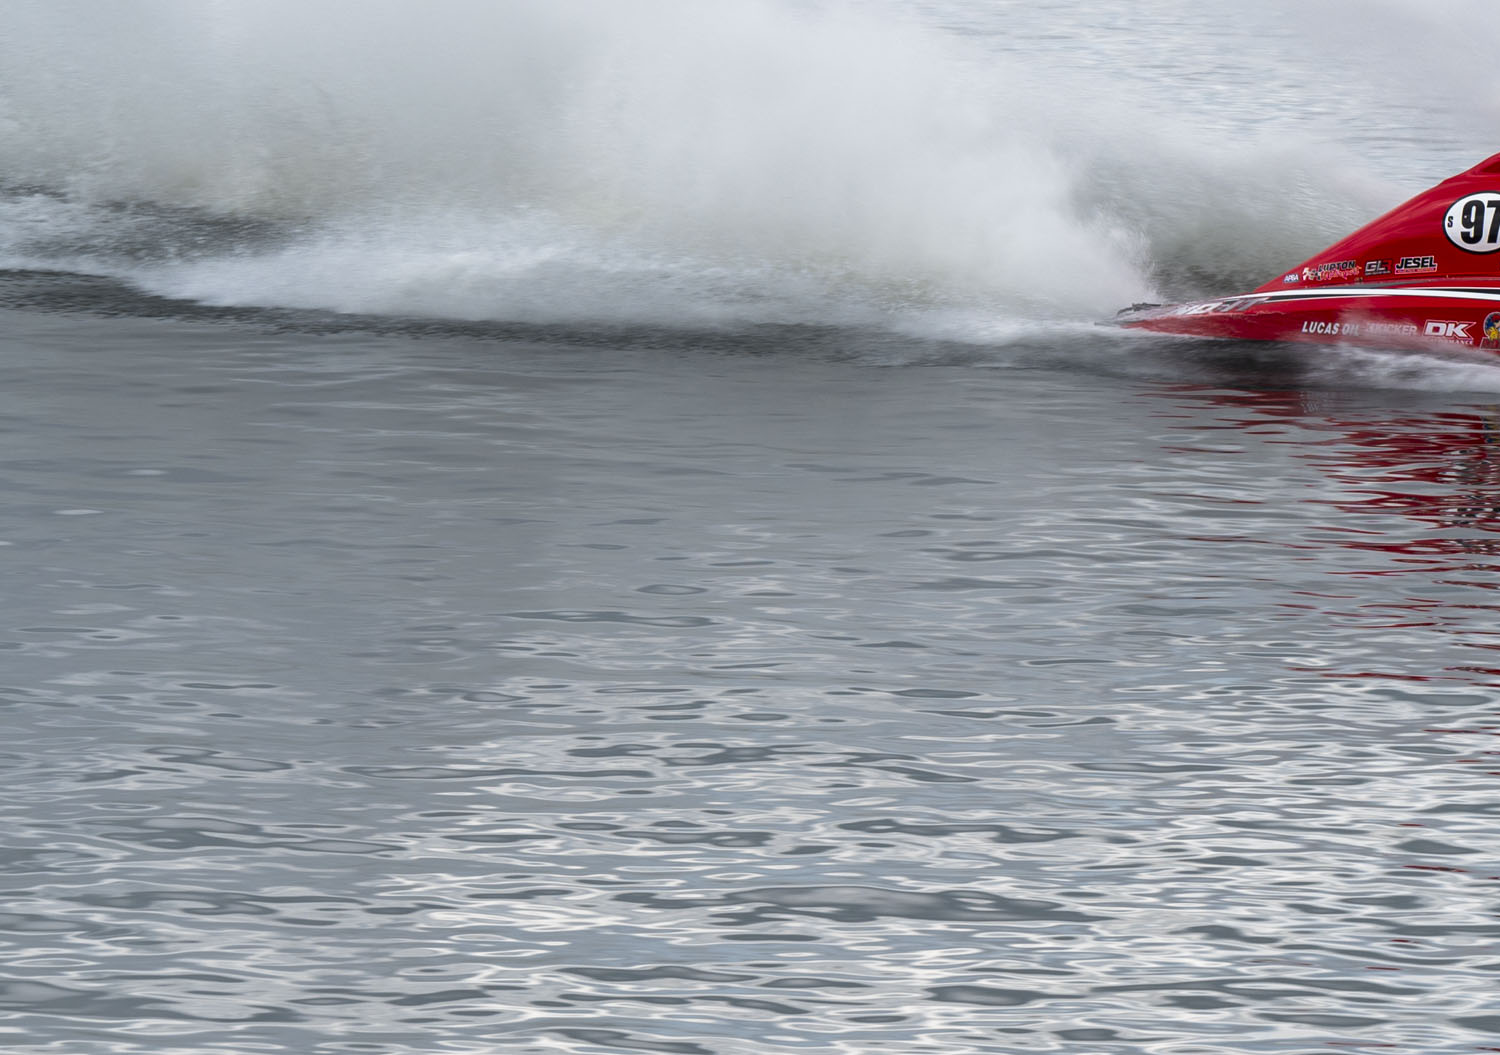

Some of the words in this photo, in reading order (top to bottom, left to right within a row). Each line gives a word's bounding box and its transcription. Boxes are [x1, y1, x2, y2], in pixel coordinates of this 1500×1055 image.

[1447, 215, 1454, 228] S
[1318, 260, 1356, 272] LUPTON
[1395, 256, 1438, 269] JESEL
[1302, 321, 1339, 335] LUCAS
[1341, 322, 1359, 336] OIL
[1424, 321, 1472, 338] DK
